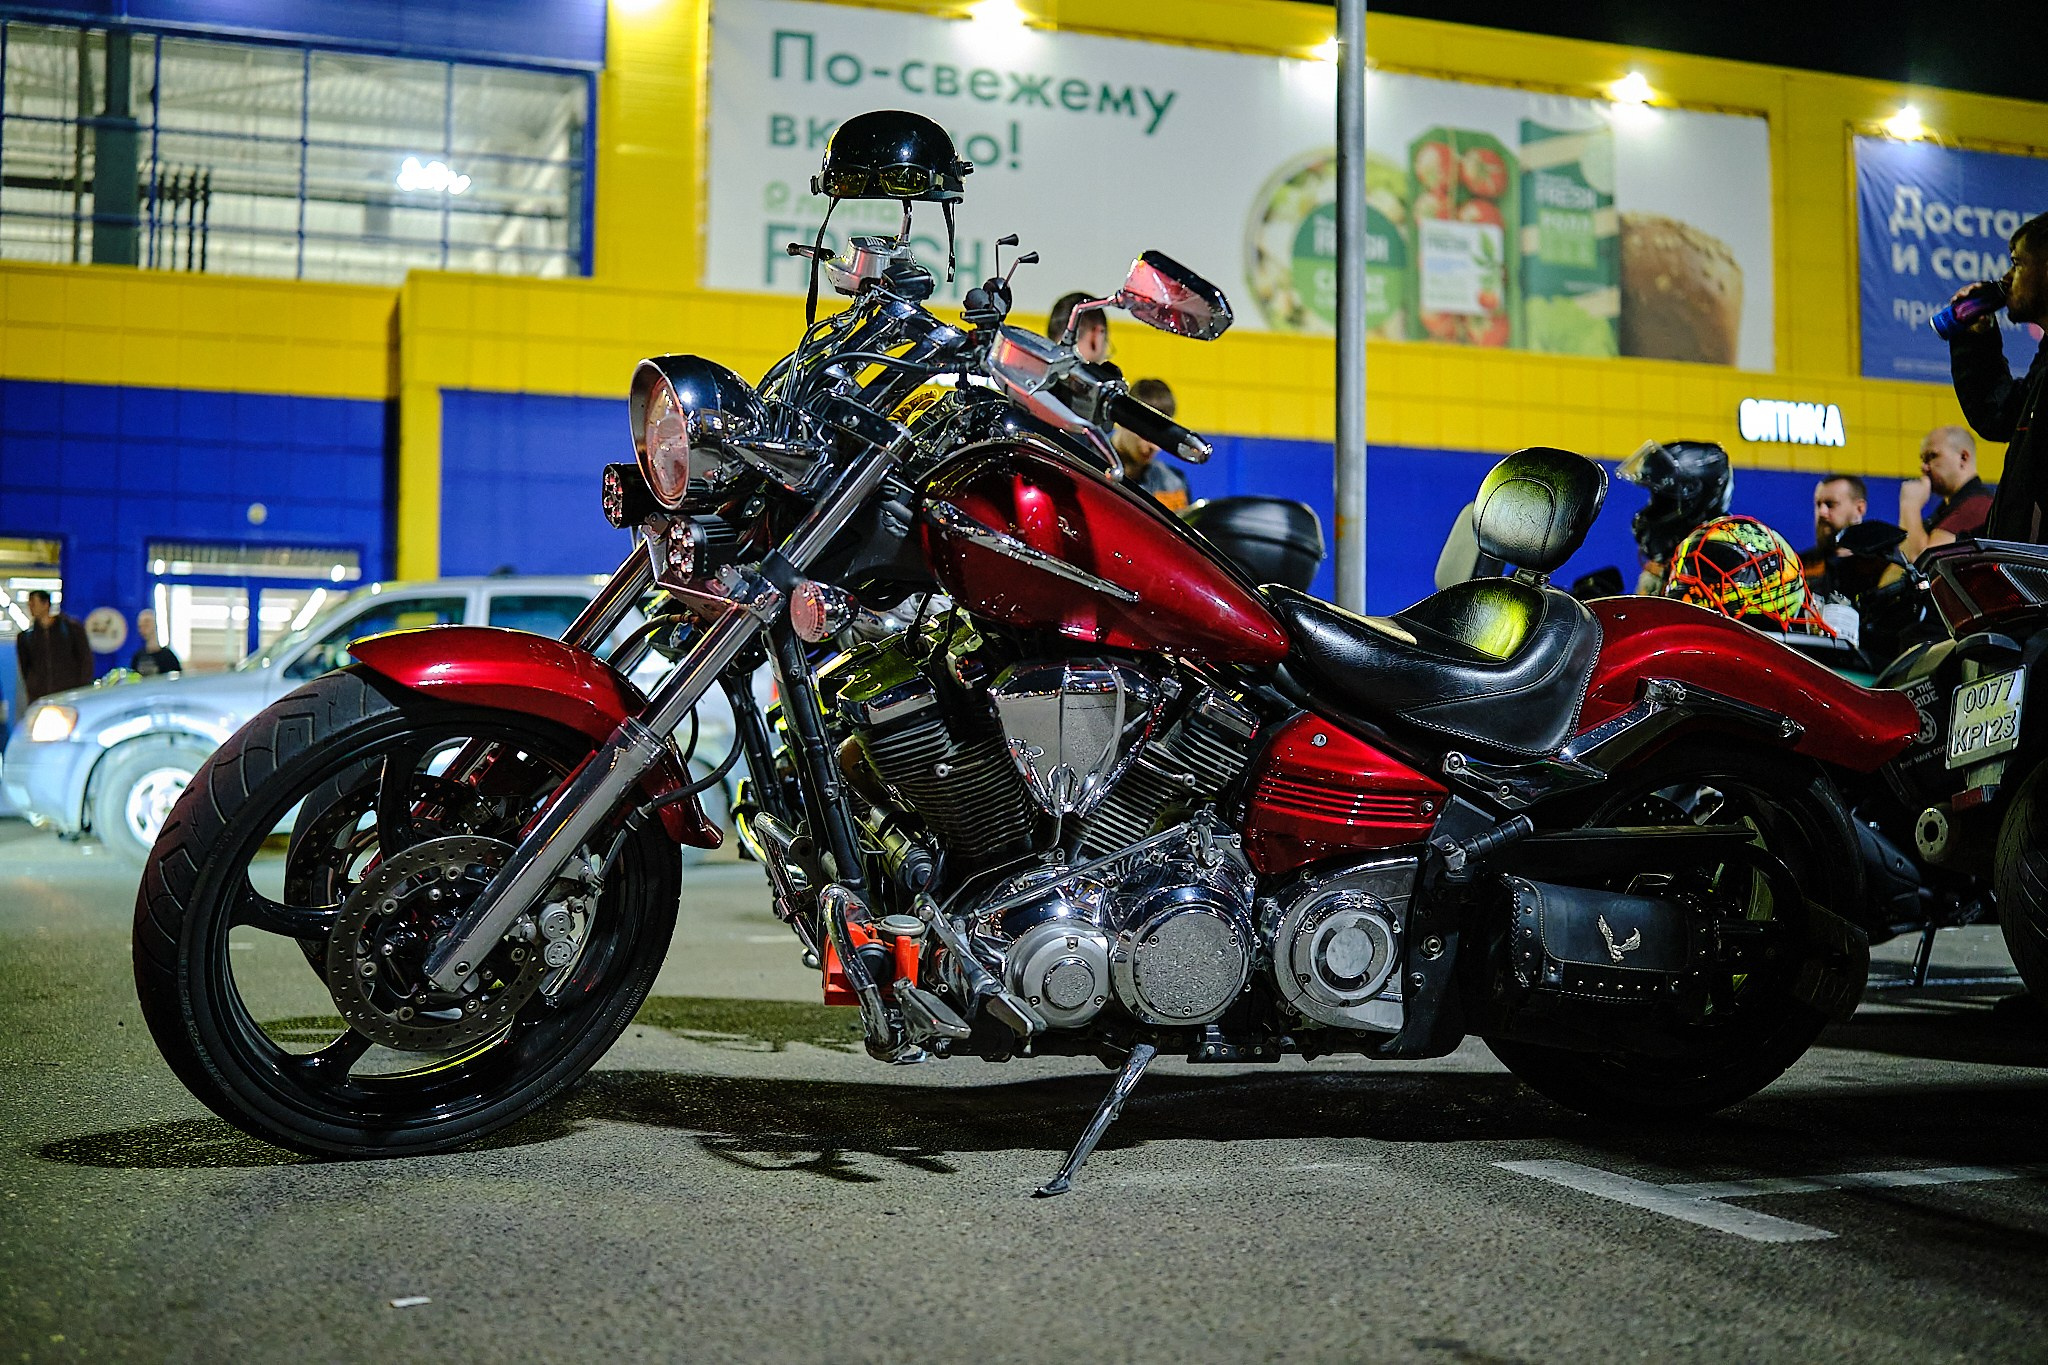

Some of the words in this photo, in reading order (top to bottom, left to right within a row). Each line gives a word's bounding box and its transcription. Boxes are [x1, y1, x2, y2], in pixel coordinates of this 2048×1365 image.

[772, 29, 1178, 135] По-свежему
[769, 114, 1021, 169] вко!
[1889, 184, 2040, 240] Доста
[766, 223, 982, 299] FRSH
[1892, 242, 1919, 276] и
[1931, 246, 2012, 281] сам
[1964, 673, 2016, 713] 0077
[1988, 709, 2017, 743] 23
